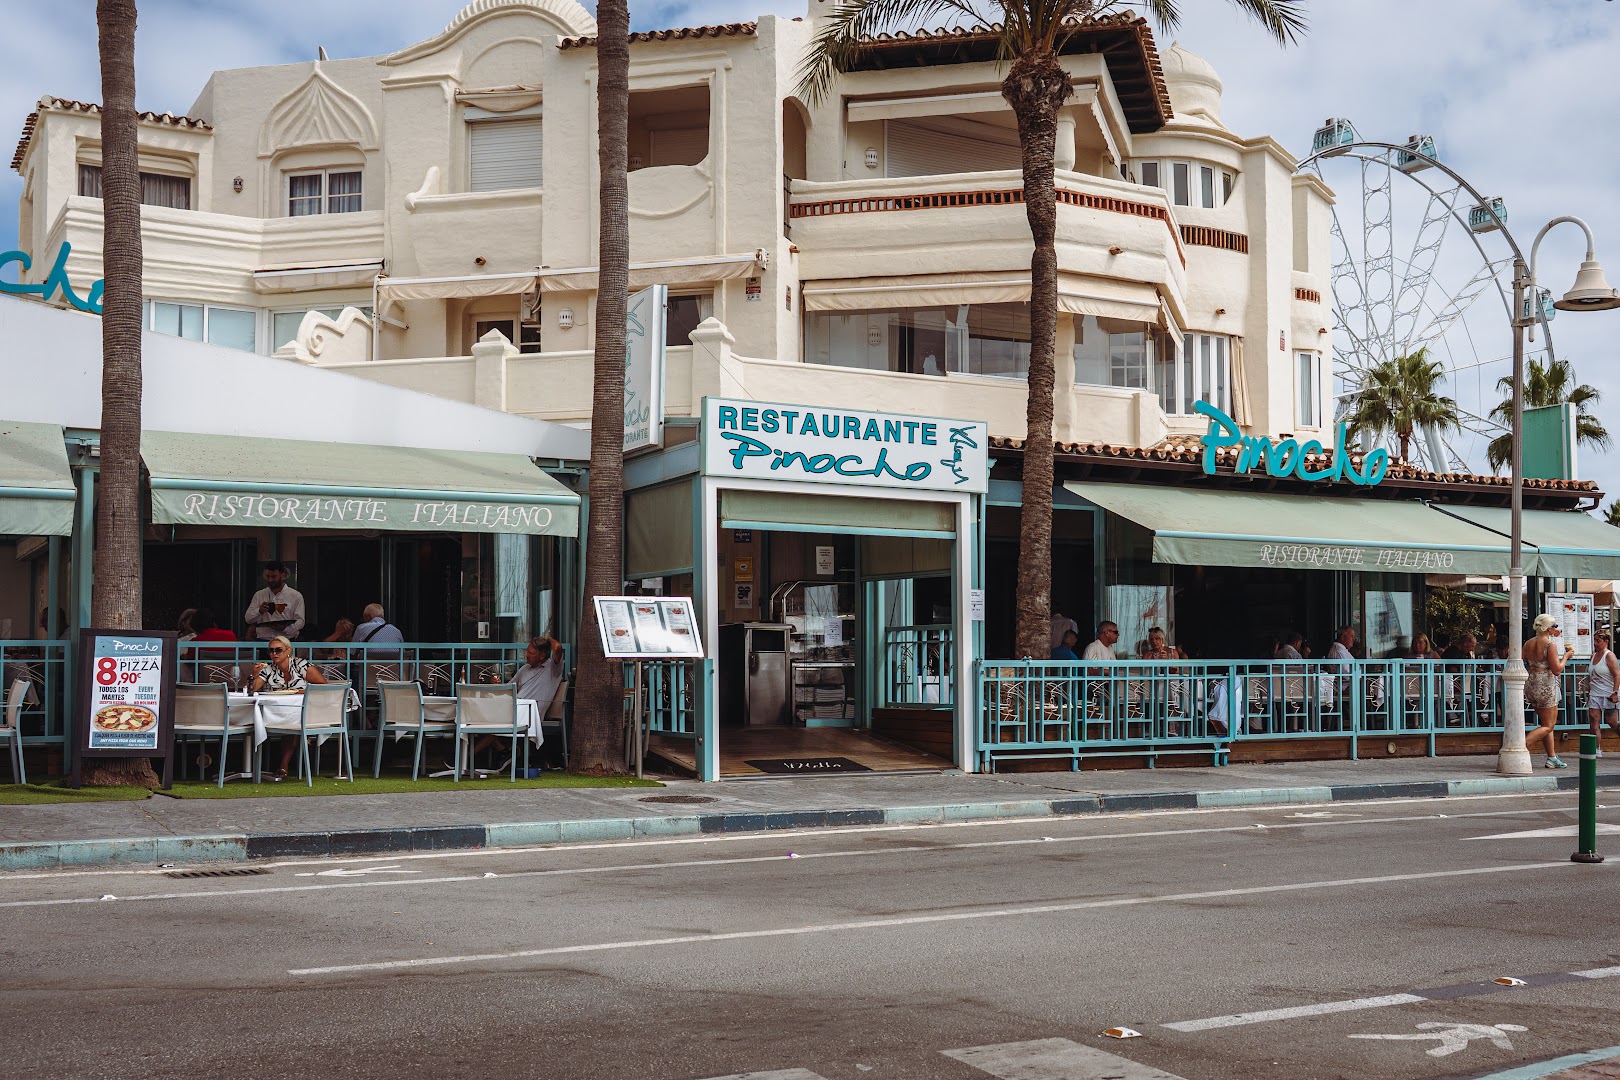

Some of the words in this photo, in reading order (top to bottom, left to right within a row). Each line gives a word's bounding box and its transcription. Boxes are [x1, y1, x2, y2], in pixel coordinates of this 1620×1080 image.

[718, 405, 938, 446] RESTAURANTE
[1190, 400, 1389, 486] Pinocho
[720, 431, 932, 482] Pinocho
[184, 493, 388, 522] RISTORANTE
[410, 502, 553, 528] ITALIANO
[1260, 544, 1366, 567] RISTORANTE
[1375, 549, 1454, 569] ITALIANO
[113, 640, 159, 652] Pinocho
[120, 661, 160, 672] PIZZA
